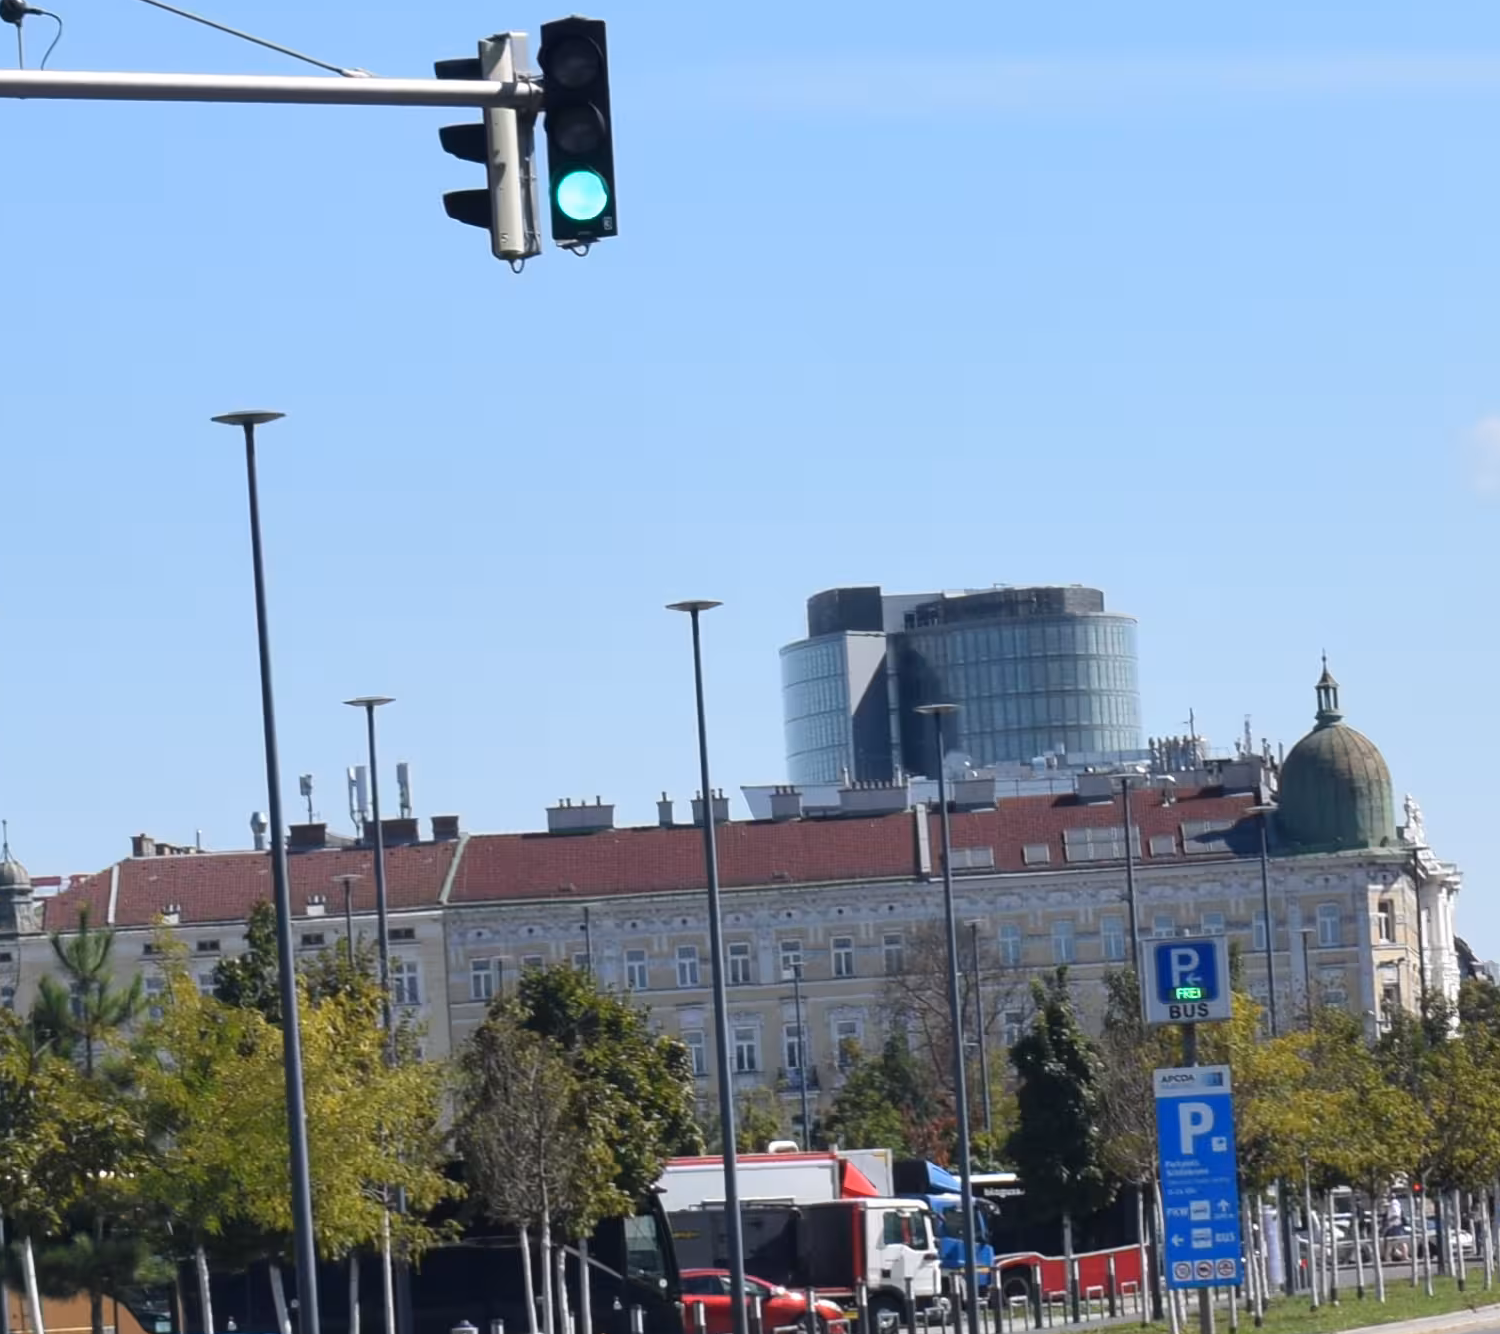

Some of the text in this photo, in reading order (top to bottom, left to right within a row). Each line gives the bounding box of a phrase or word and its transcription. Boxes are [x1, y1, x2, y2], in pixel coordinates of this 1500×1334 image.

[1171, 948, 1199, 987] P
[1169, 1003, 1209, 1019] BUS
[1178, 1102, 1214, 1155] P
